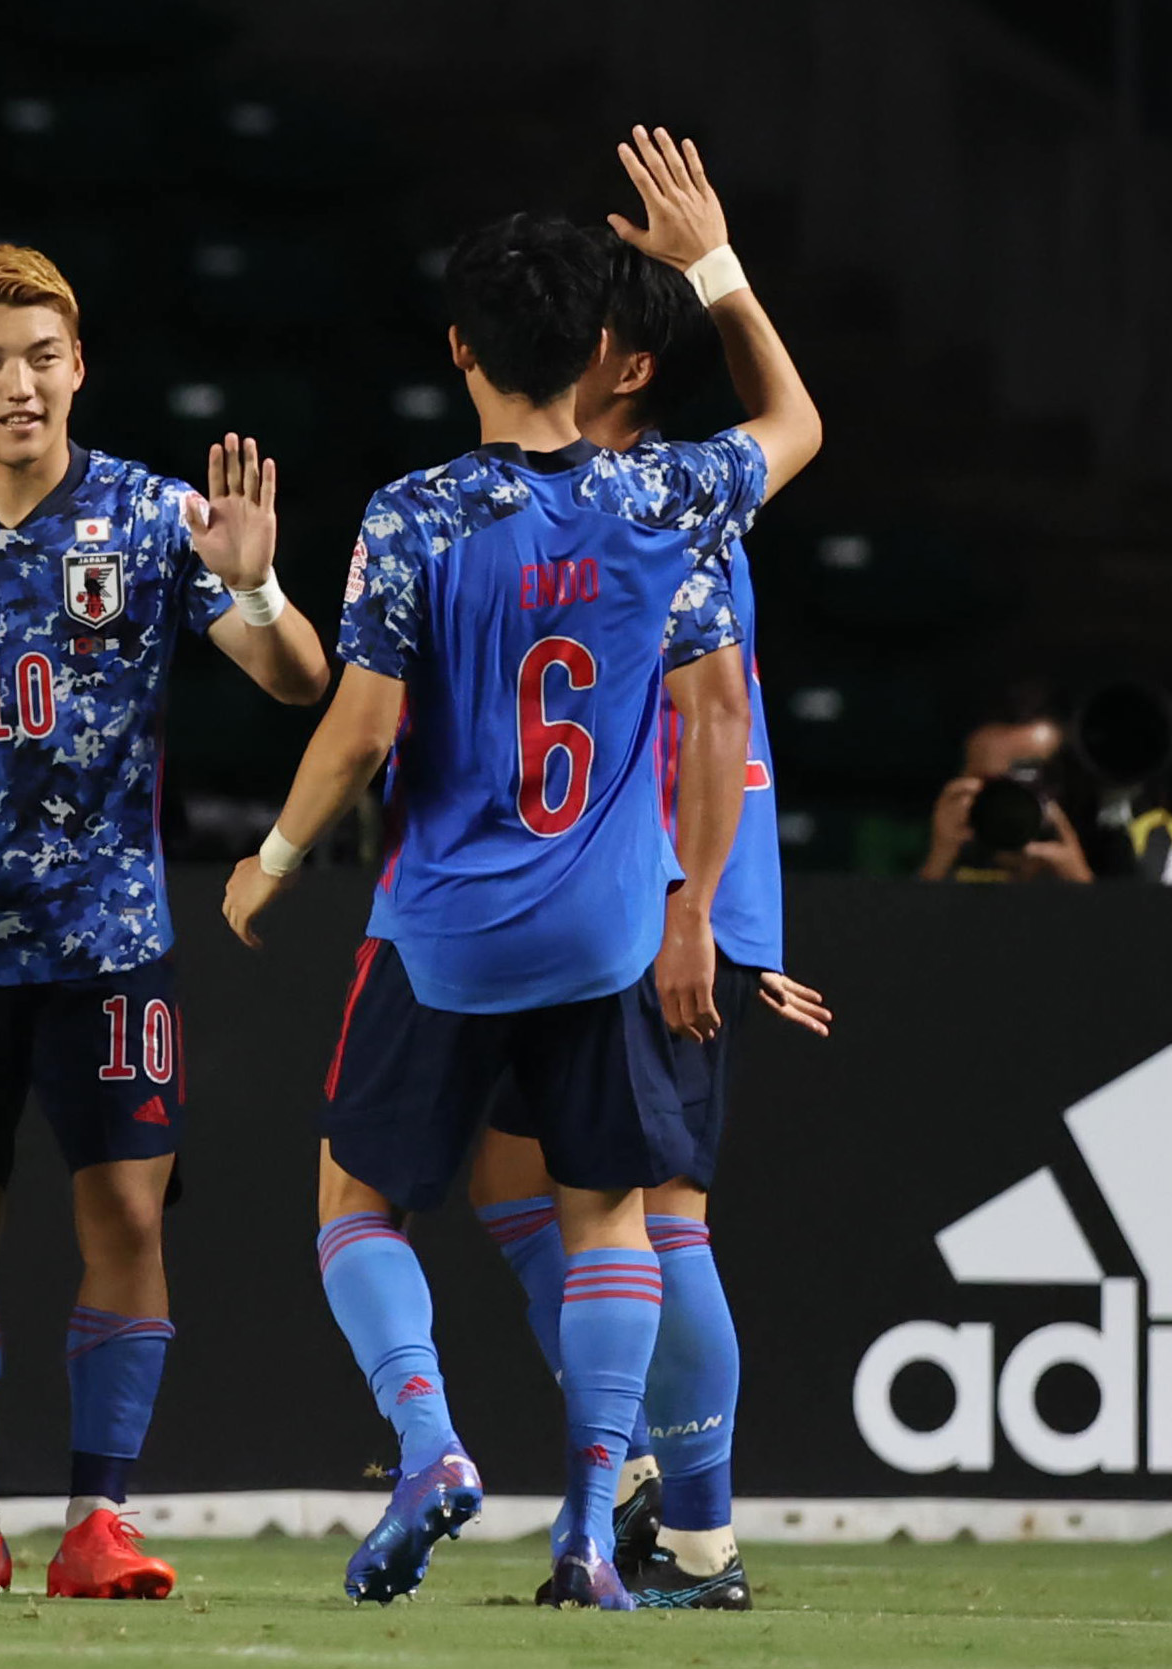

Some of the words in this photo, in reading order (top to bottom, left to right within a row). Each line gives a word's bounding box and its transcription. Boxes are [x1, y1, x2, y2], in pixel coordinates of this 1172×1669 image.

[78, 556, 108, 564] JAPAN
[519, 558, 599, 610] ENDO
[516, 635, 597, 838] 6
[99, 995, 173, 1084] 10
